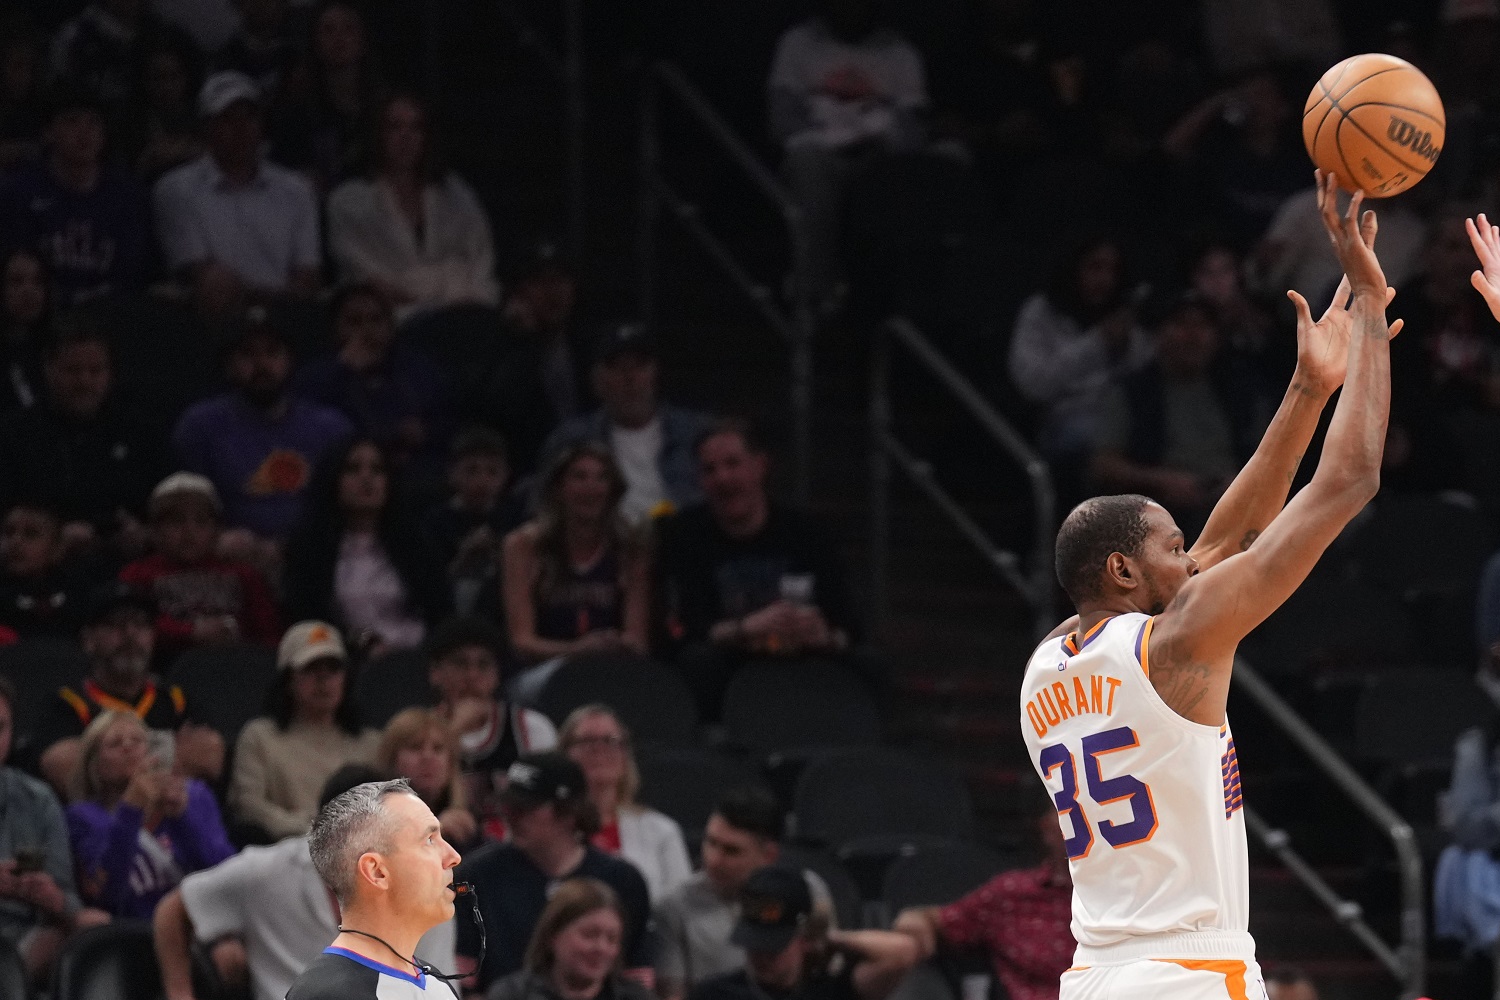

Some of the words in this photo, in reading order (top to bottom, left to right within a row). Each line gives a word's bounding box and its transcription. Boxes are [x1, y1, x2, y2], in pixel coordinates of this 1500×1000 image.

[1386, 115, 1441, 162] Wilso
[1026, 675, 1122, 738] DURANT
[1040, 726, 1159, 862] 35
